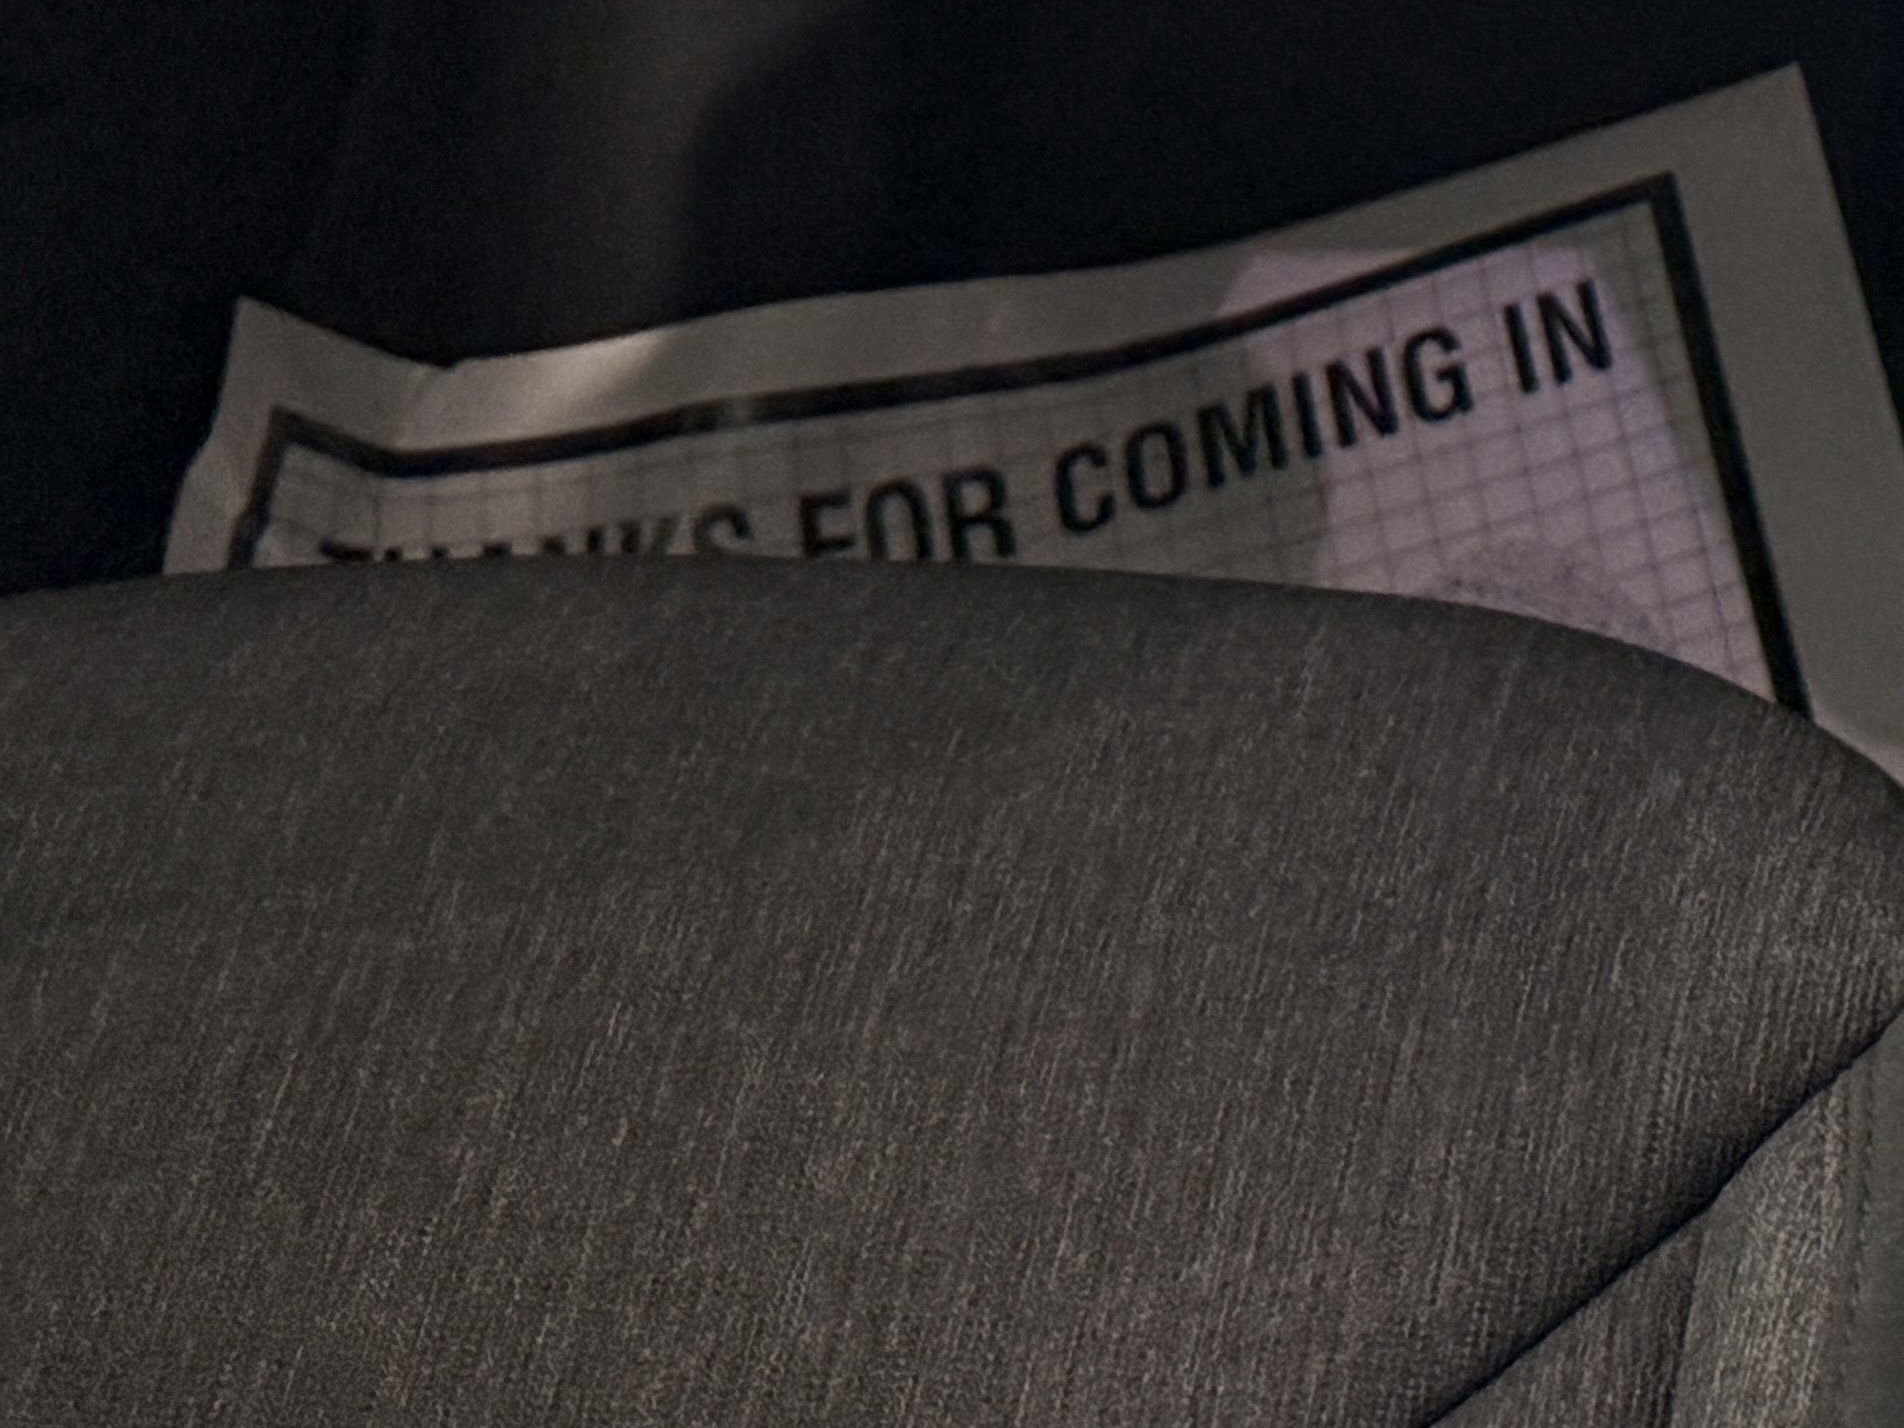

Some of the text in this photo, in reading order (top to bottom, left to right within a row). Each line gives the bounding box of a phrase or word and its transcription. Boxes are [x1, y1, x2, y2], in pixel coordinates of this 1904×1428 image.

[800, 466, 1015, 561] FOR
[1053, 325, 1474, 535] COMING
[1502, 277, 1615, 394] IN
